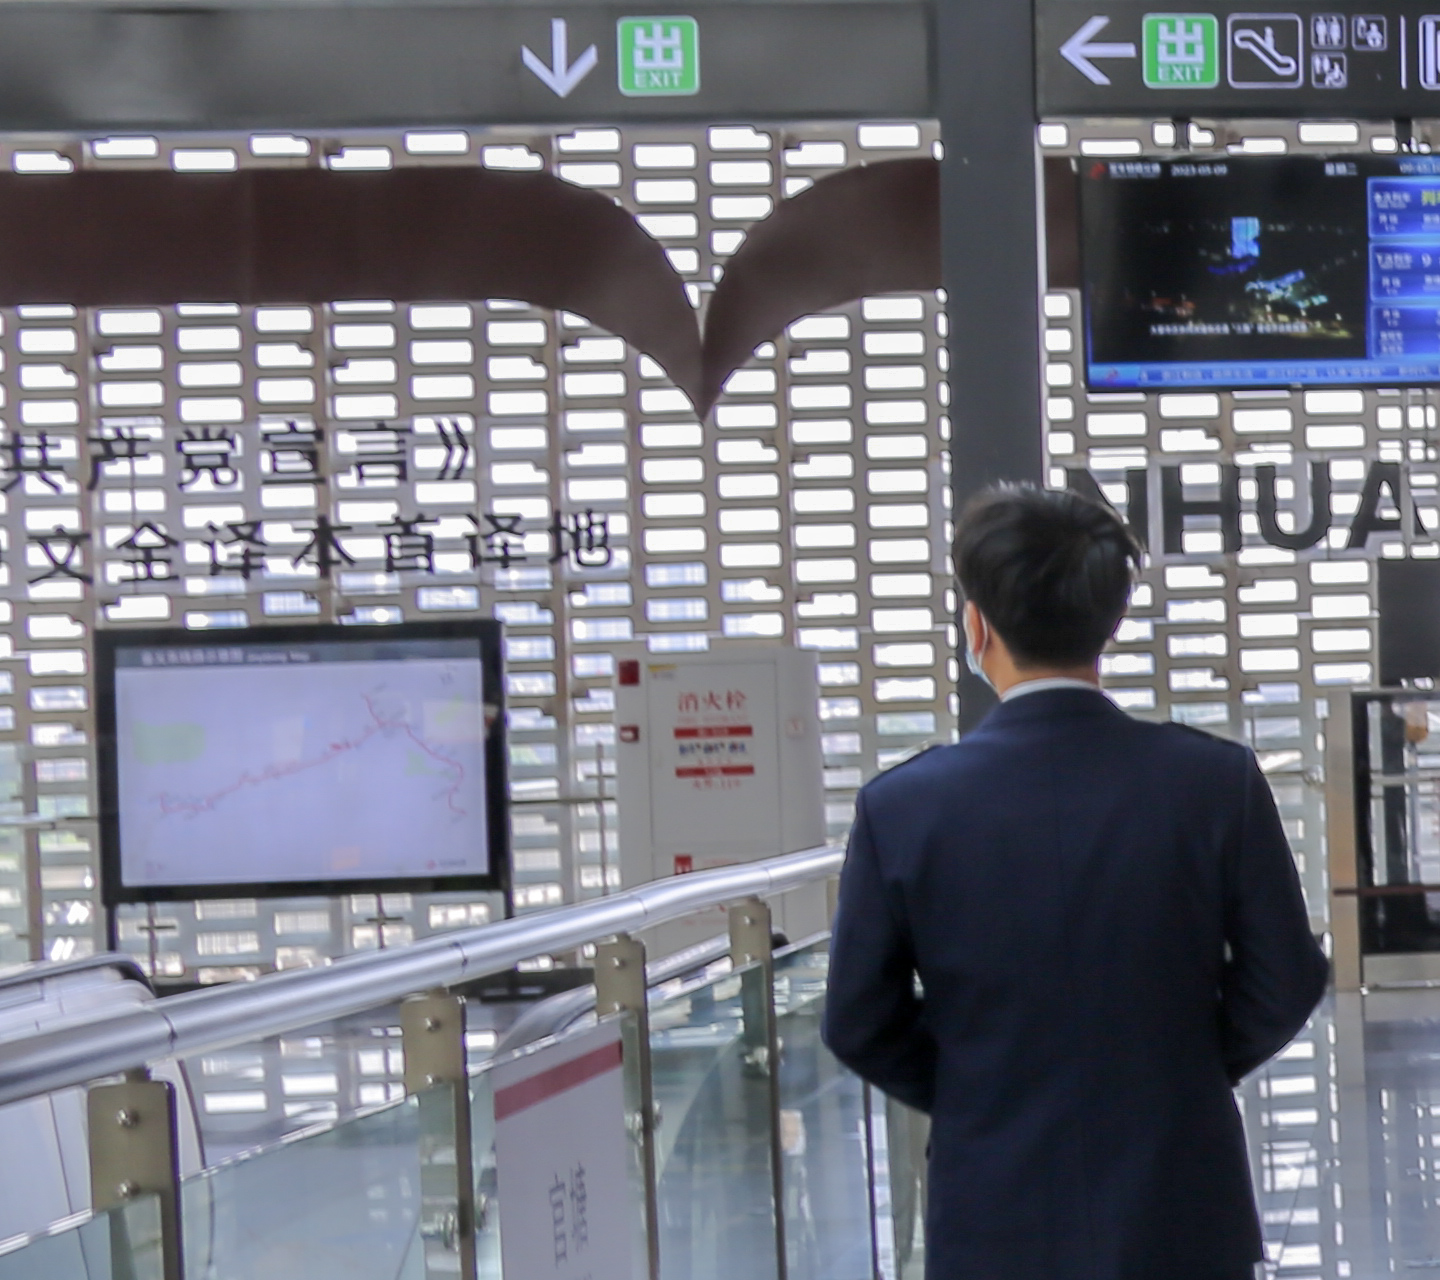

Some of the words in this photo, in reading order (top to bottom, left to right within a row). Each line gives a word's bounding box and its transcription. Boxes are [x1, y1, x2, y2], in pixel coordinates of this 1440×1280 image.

[633, 24, 684, 68] 出
[1157, 20, 1205, 63] 出
[634, 71, 684, 89] EXIT
[1157, 65, 1205, 82] EXIT
[677, 689, 747, 713] 消火栓
